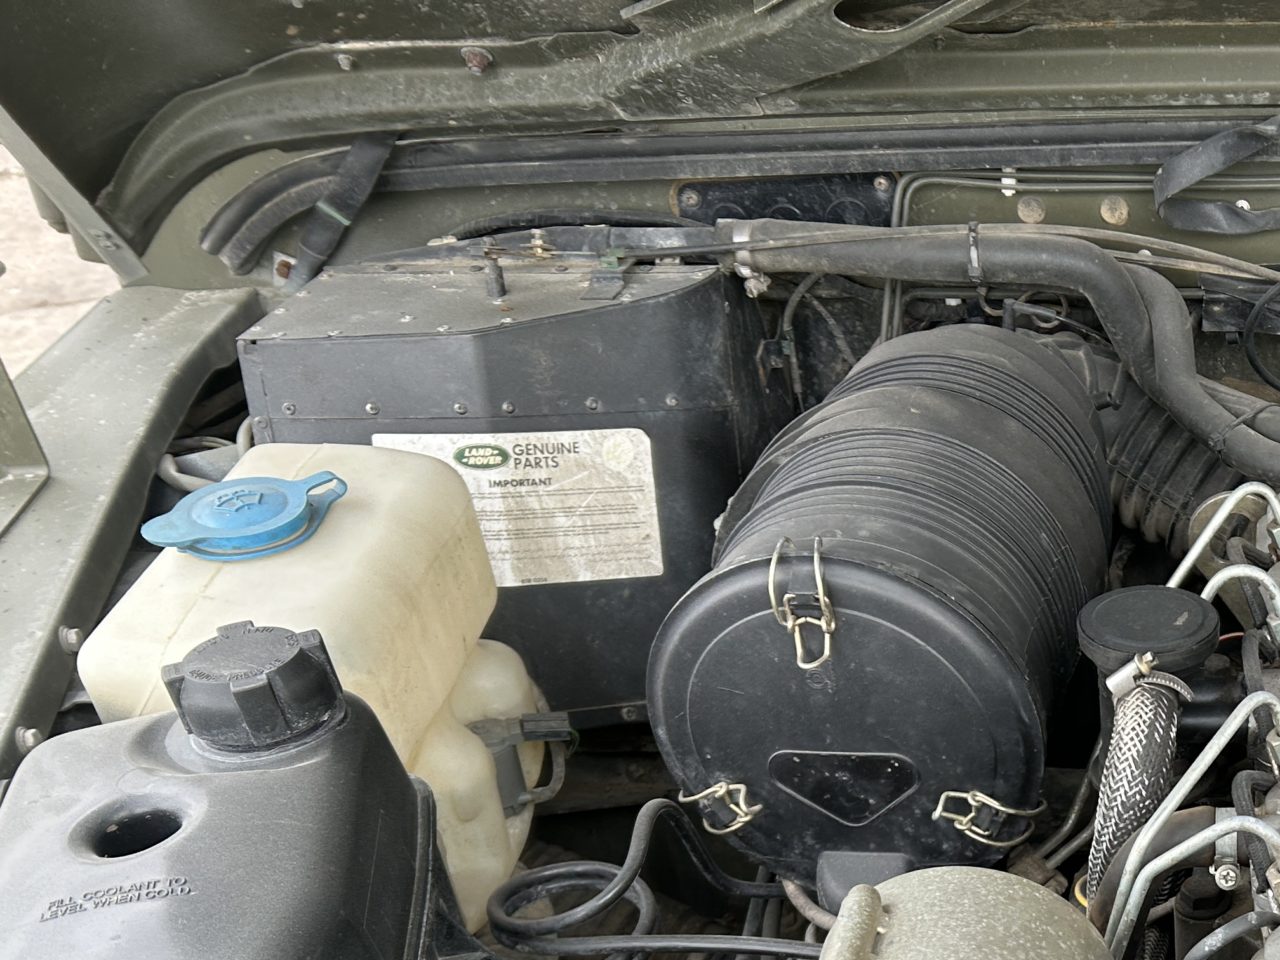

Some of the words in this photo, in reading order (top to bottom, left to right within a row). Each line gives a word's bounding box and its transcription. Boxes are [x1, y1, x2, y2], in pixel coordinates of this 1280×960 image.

[464, 447, 492, 458] LAND
[512, 442, 580, 456] GENUINE
[467, 456, 502, 466] ROVER
[513, 457, 560, 470] PARTS
[488, 477, 553, 488] IMPORTANT
[47, 896, 76, 910] FILL
[82, 879, 162, 902] COOLANT
[166, 876, 188, 888] TO
[39, 903, 88, 922] LEVEL
[92, 893, 141, 909] WHEN
